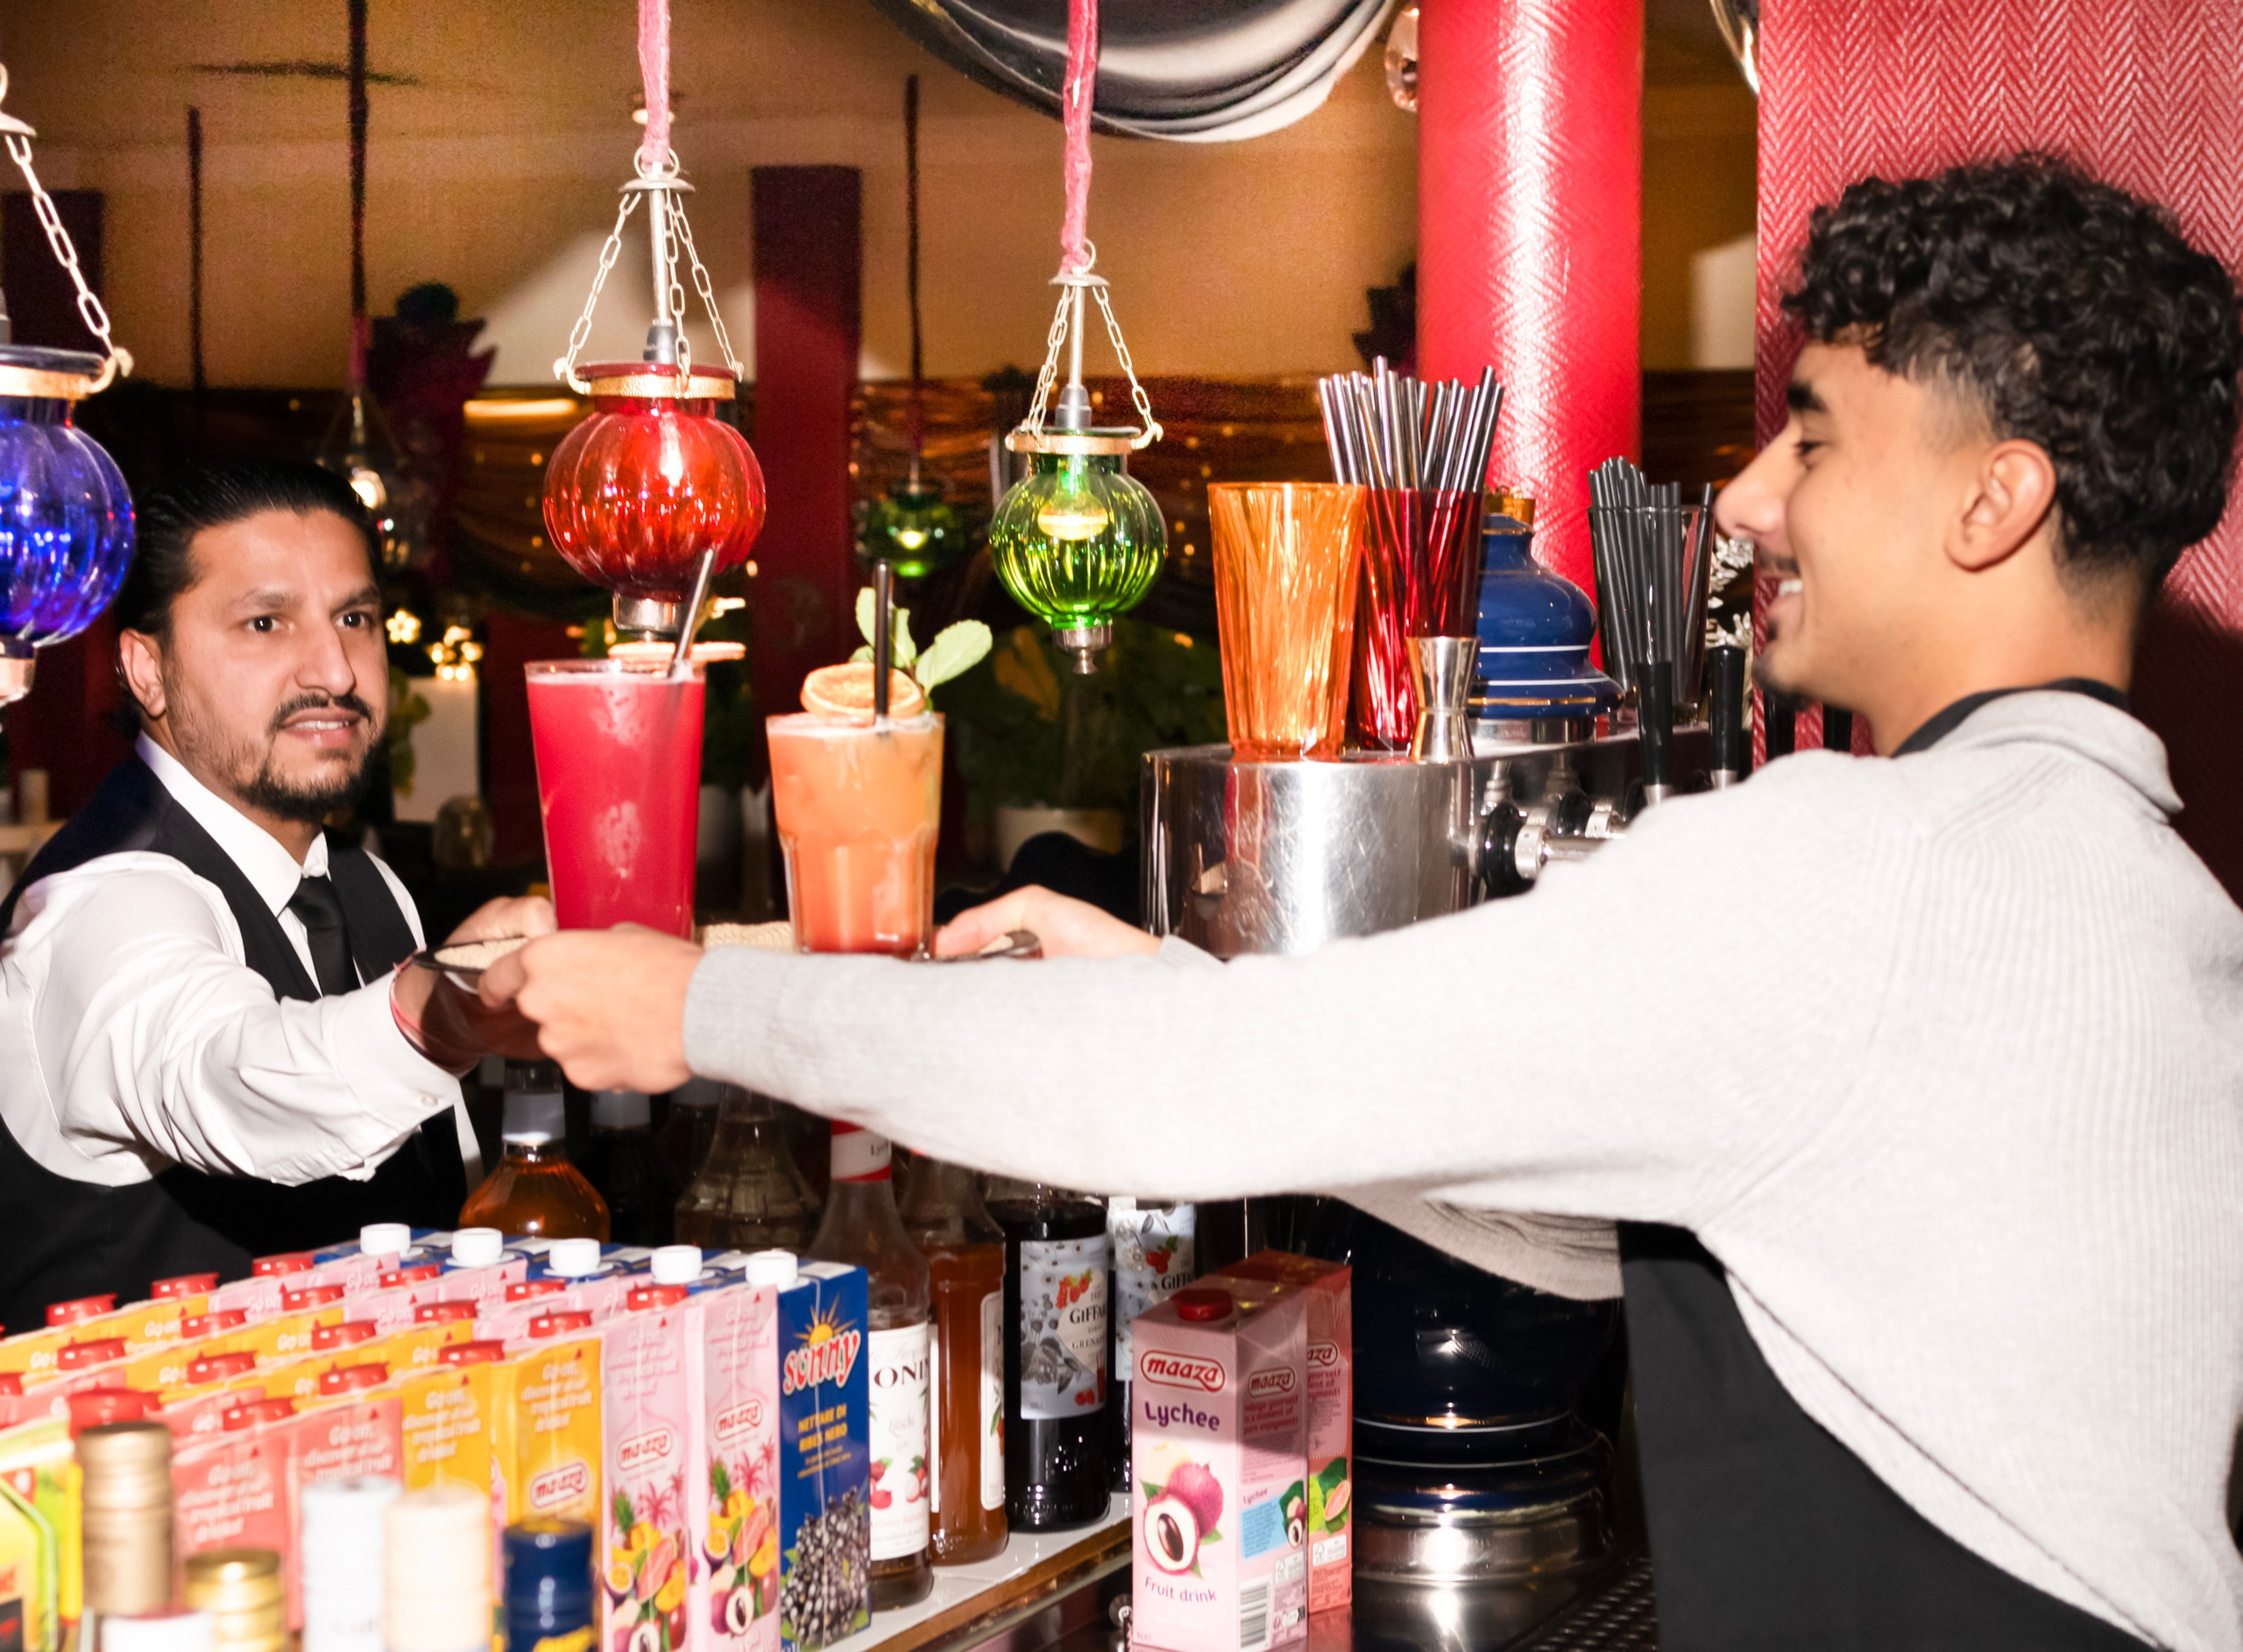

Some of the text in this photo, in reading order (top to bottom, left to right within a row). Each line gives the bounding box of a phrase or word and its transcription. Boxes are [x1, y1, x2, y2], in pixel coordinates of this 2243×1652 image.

[1146, 1356, 1220, 1385] maaza
[1250, 1373, 1292, 1391] maaza
[1144, 1401, 1221, 1432] Lychee
[1145, 1576, 1218, 1602] Fruit drink
